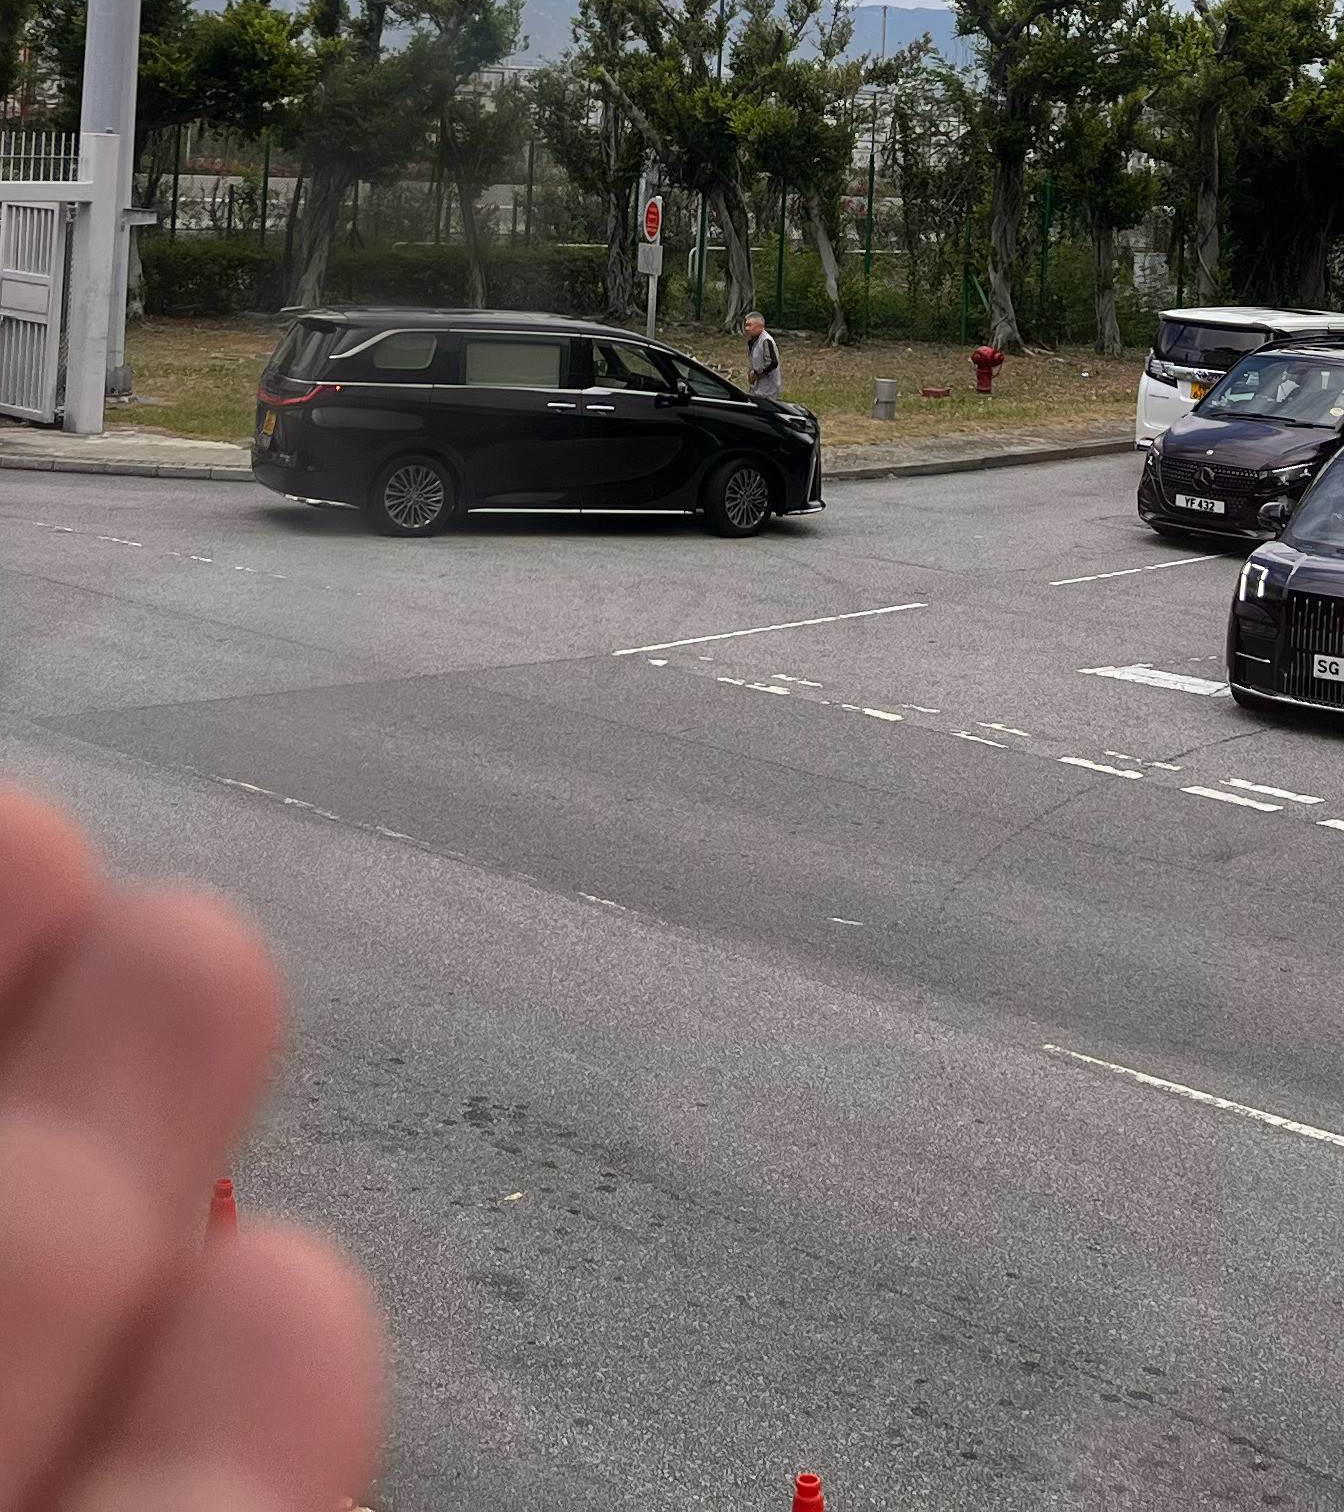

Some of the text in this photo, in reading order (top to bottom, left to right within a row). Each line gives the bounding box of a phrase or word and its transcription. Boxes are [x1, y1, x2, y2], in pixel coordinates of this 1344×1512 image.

[1184, 496, 1215, 512] YF 432
[1317, 659, 1339, 676] SG
